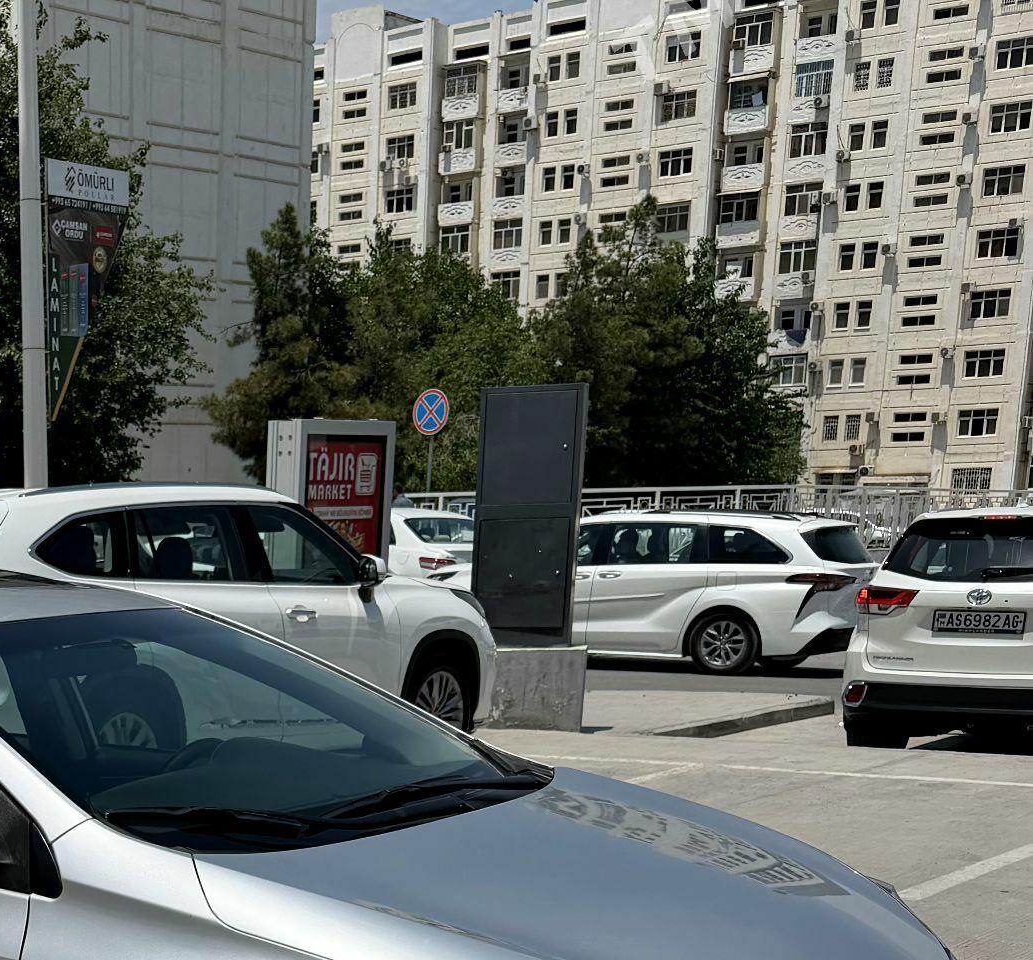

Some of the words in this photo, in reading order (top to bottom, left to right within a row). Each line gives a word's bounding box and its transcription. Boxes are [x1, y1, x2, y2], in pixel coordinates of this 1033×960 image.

[65, 230, 84, 239] ORDU
[50, 257, 60, 391] LAMINAT
[308, 447, 355, 481] TÄJIR
[308, 484, 353, 500] MARKET
[946, 613, 1019, 629] AS6982AG
